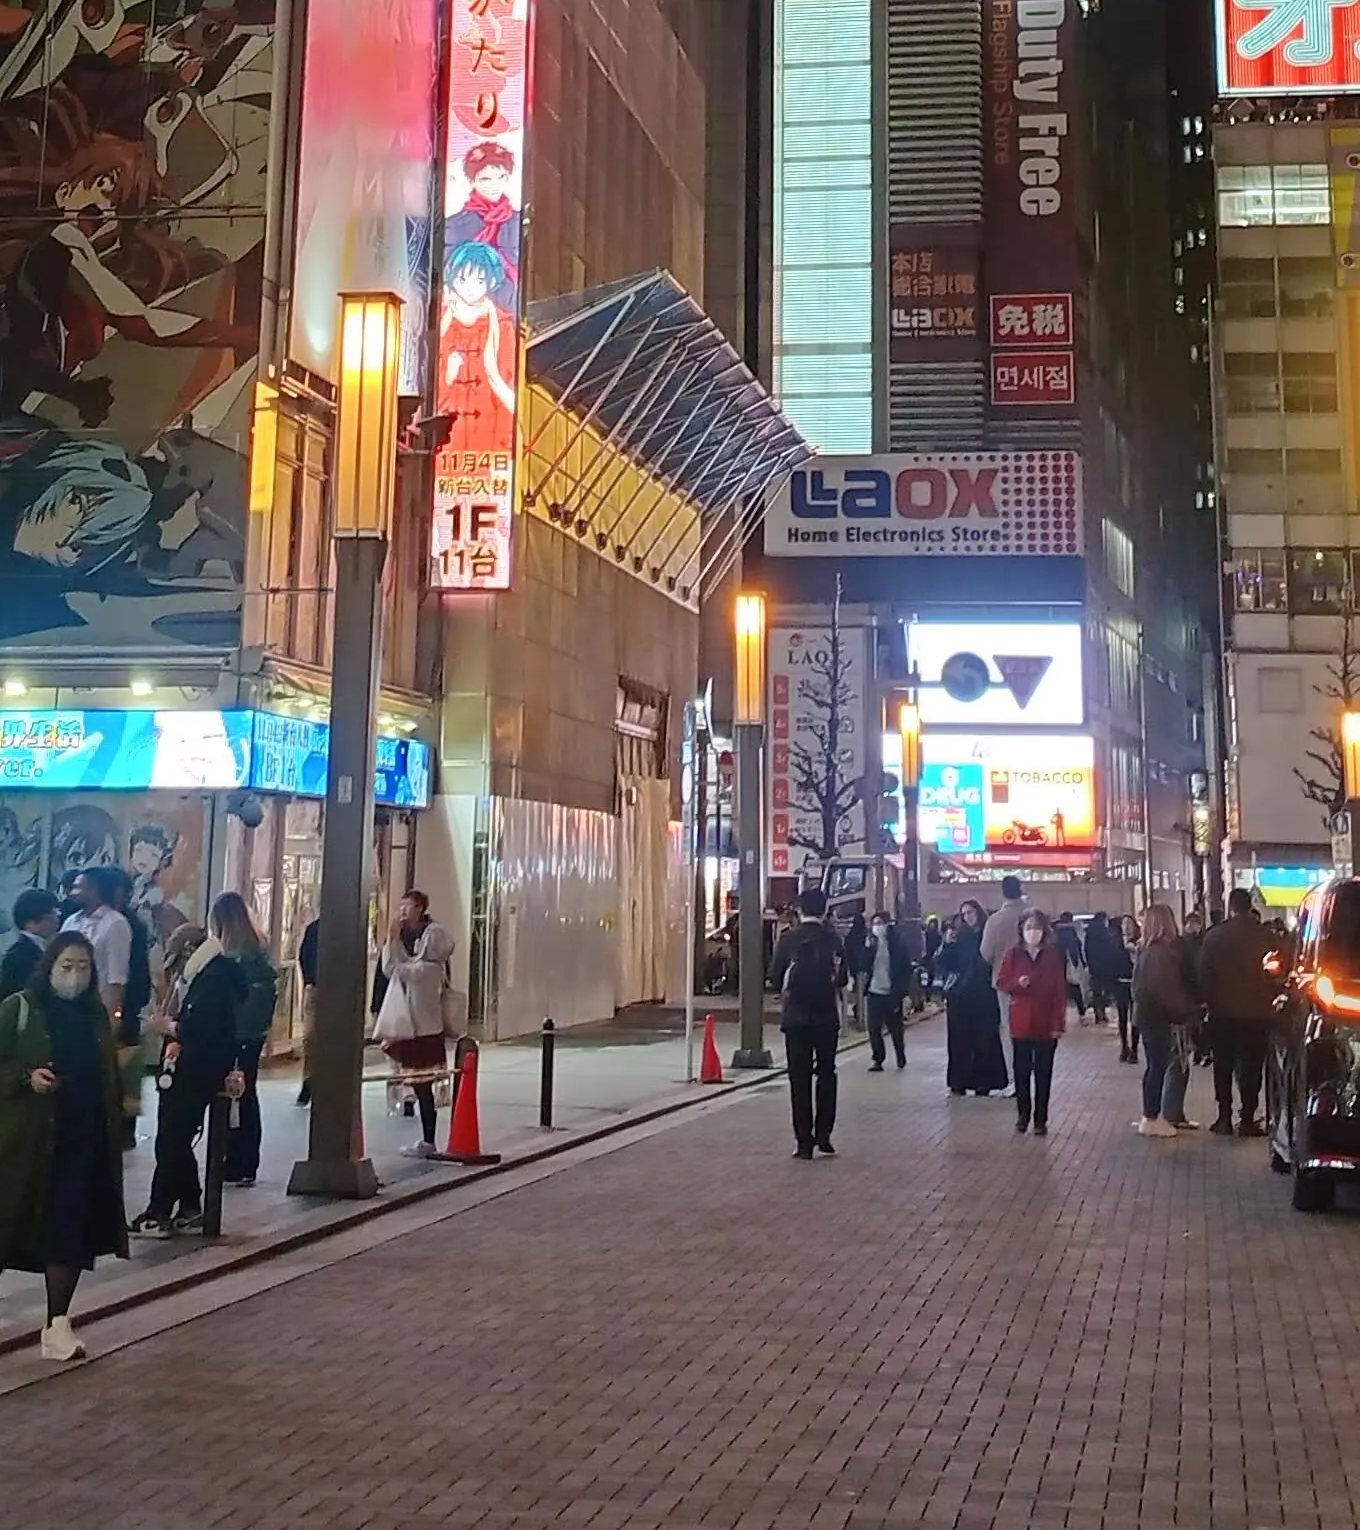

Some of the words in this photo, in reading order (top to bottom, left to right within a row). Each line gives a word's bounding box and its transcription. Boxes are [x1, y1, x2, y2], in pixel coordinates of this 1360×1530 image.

[989, 0, 1012, 94] Flagship
[993, 101, 1014, 166] Store
[1017, 112, 1068, 217] Free
[996, 302, 1066, 337] 免税
[995, 364, 1069, 394] 면세점
[441, 453, 509, 472] 11月4日
[445, 504, 499, 542] 1F
[786, 527, 840, 545] Home
[845, 525, 946, 545] Electronics
[950, 526, 1003, 545] Store
[440, 546, 499, 577] 11台
[1012, 771, 1084, 785] TOBACCO
